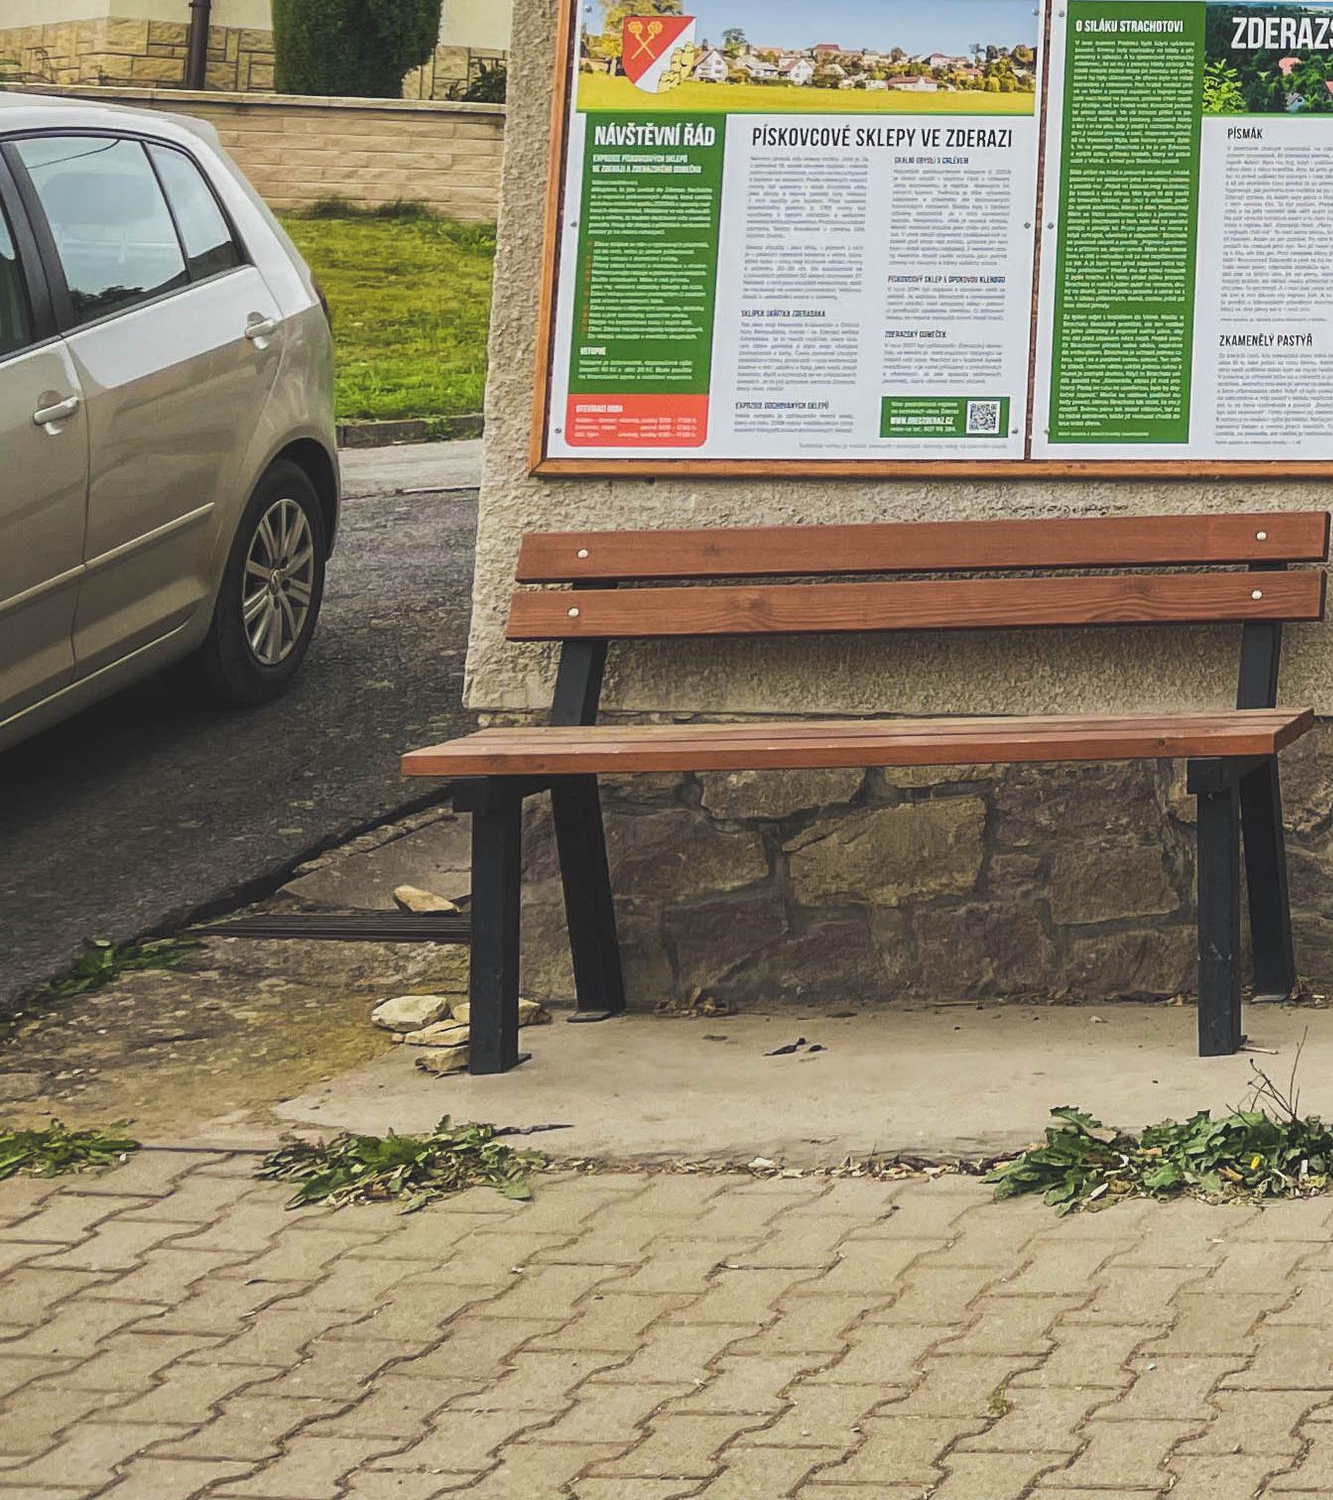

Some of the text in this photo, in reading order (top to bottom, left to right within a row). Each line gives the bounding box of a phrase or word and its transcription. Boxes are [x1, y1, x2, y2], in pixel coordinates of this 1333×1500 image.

[1075, 18, 1184, 34] O SILÁKU STRACHOTOVI
[594, 122, 716, 147] NÁVŠTĚVNÍ ŘÁD
[752, 124, 1013, 148] PÍSKOVCOVÉ SKLEPY VE ZDERAZI
[1227, 126, 1263, 140] PÍSMÁK
[1218, 332, 1314, 347] ZKAMENĚLÝ PASTÝŘ
